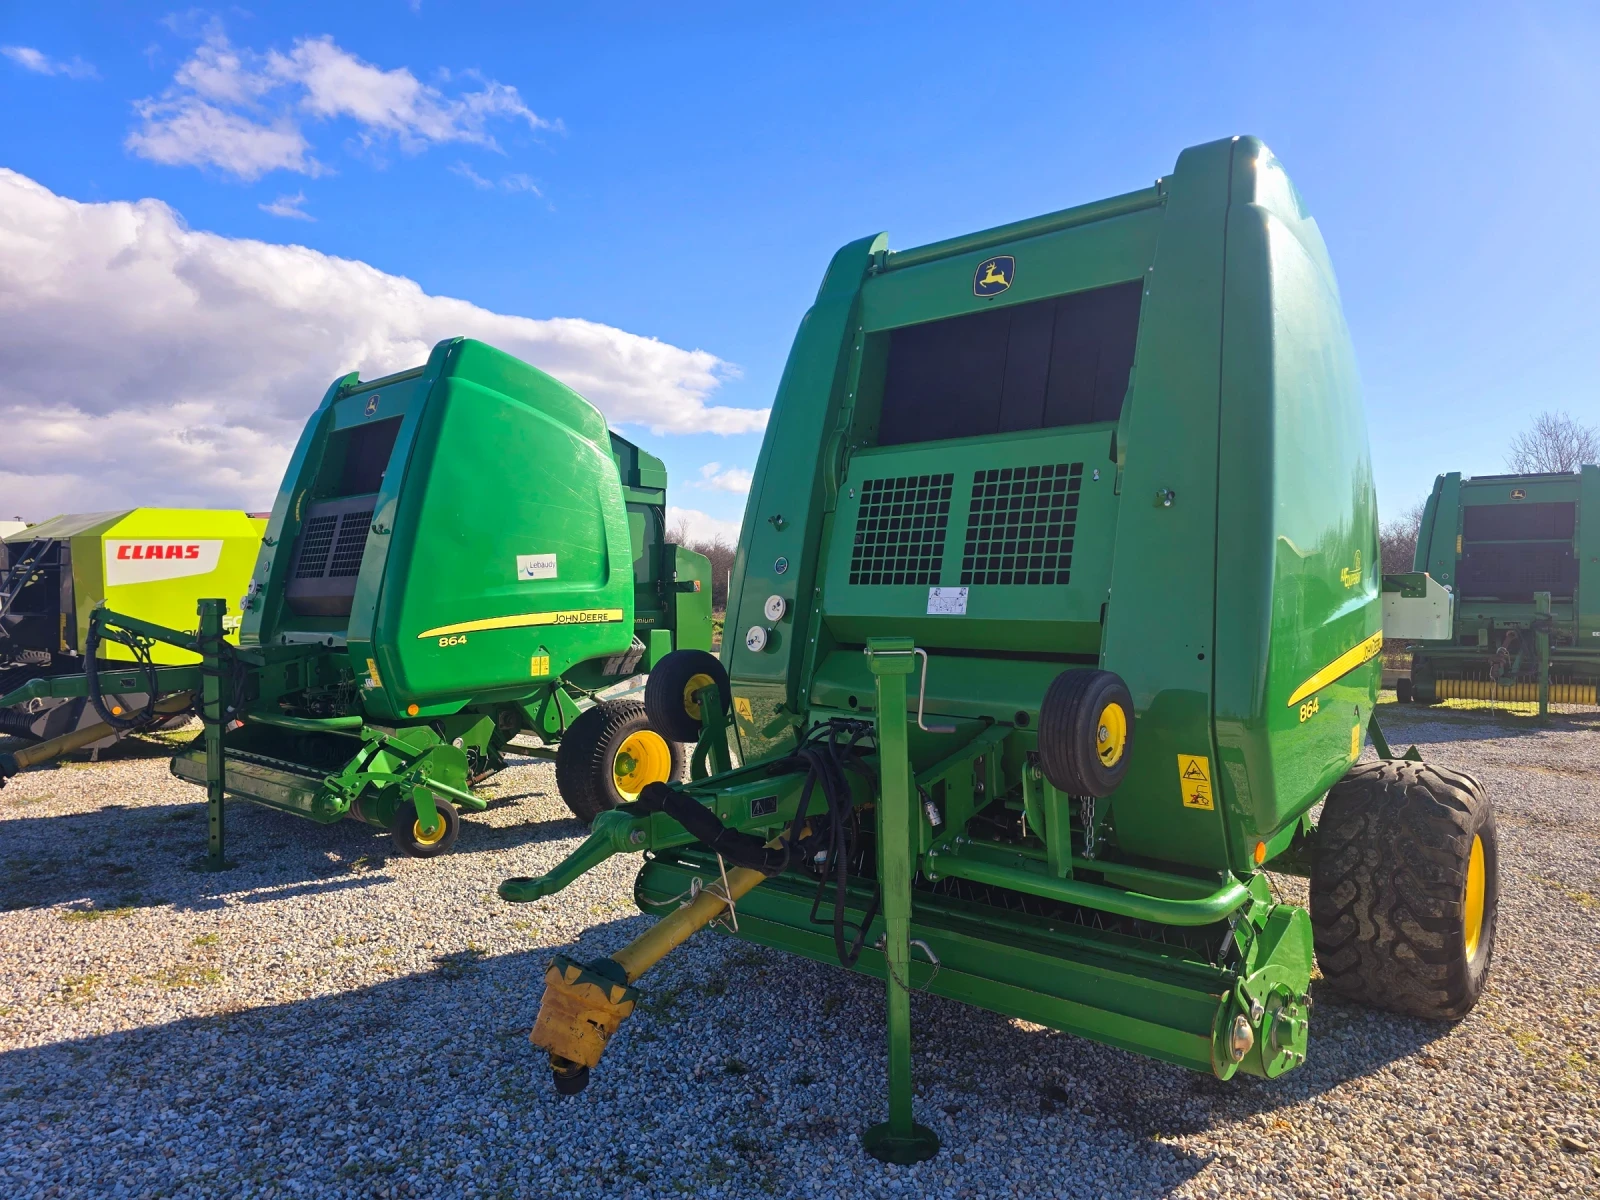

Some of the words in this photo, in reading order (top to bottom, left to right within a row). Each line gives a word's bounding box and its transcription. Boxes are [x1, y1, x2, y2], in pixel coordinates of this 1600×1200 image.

[117, 545, 200, 559] CLAAS
[529, 560, 556, 569] Lebaudy
[553, 613, 579, 625] JOHN
[579, 612, 609, 622] DEERE
[438, 634, 468, 648] 864
[1300, 697, 1319, 722] 864
